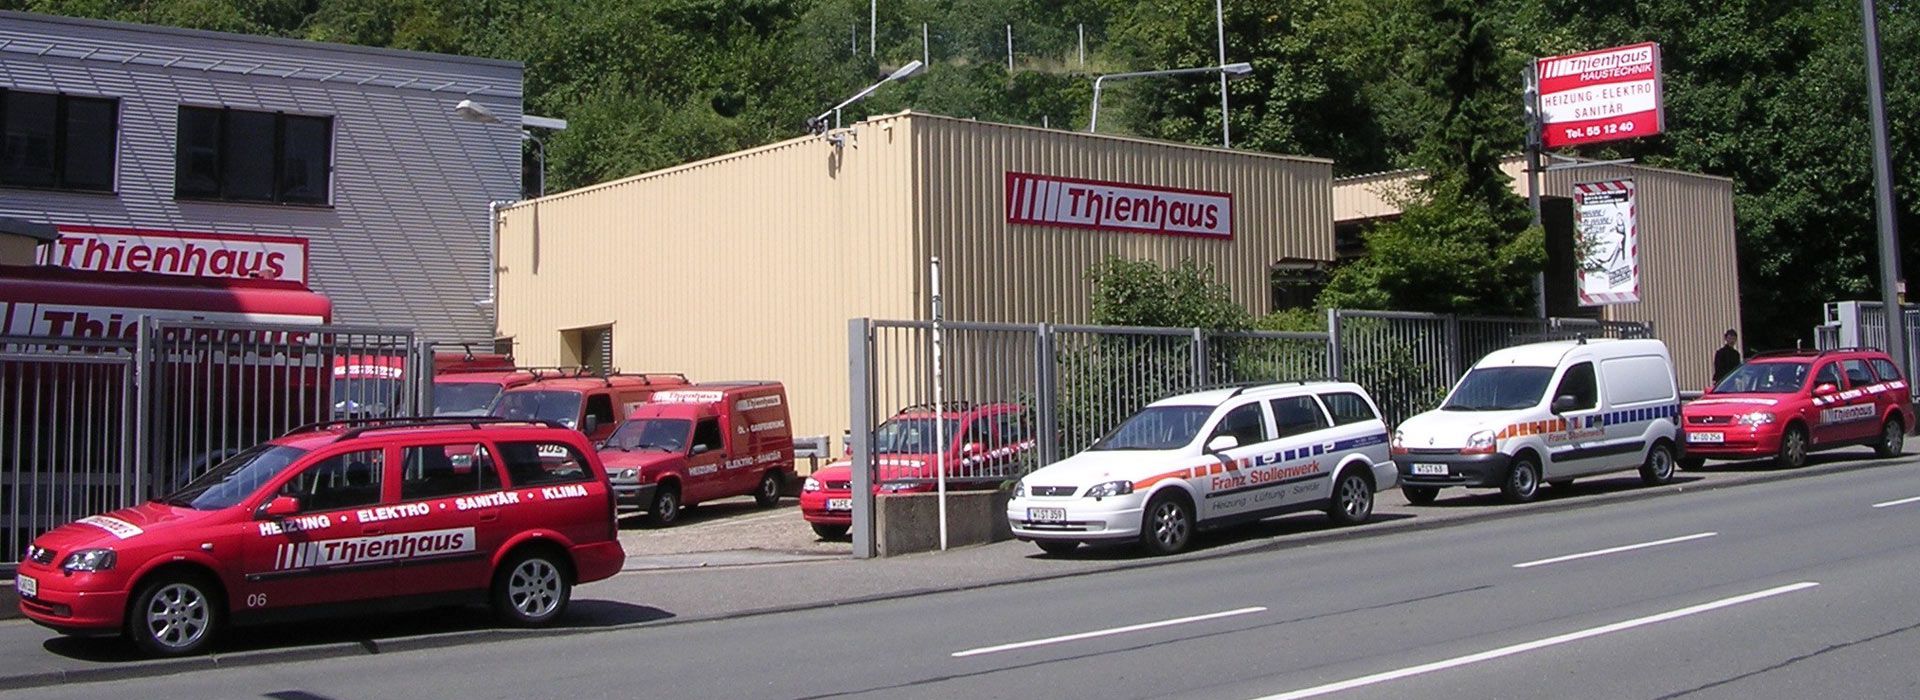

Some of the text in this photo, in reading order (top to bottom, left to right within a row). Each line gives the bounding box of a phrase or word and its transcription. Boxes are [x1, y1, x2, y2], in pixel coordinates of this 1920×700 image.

[1570, 50, 1648, 71] Thienhaus
[1580, 63, 1652, 81] HAUSTECHNIK
[1545, 91, 1592, 106] HEIZUNG
[1602, 83, 1651, 99] ELEKTRO
[1575, 102, 1624, 118] SANITÄR
[1566, 121, 1634, 139] Tel. 55 12 40
[1068, 189, 1218, 231] Thienhaus
[58, 237, 284, 278] Thienhaus
[1212, 460, 1320, 490] Franz Stollenwerk
[259, 485, 588, 536] HEIZUNG ELEKTRO SANITÄR KLIMA
[324, 535, 464, 562] Thienhaus
[247, 593, 267, 607] 06
